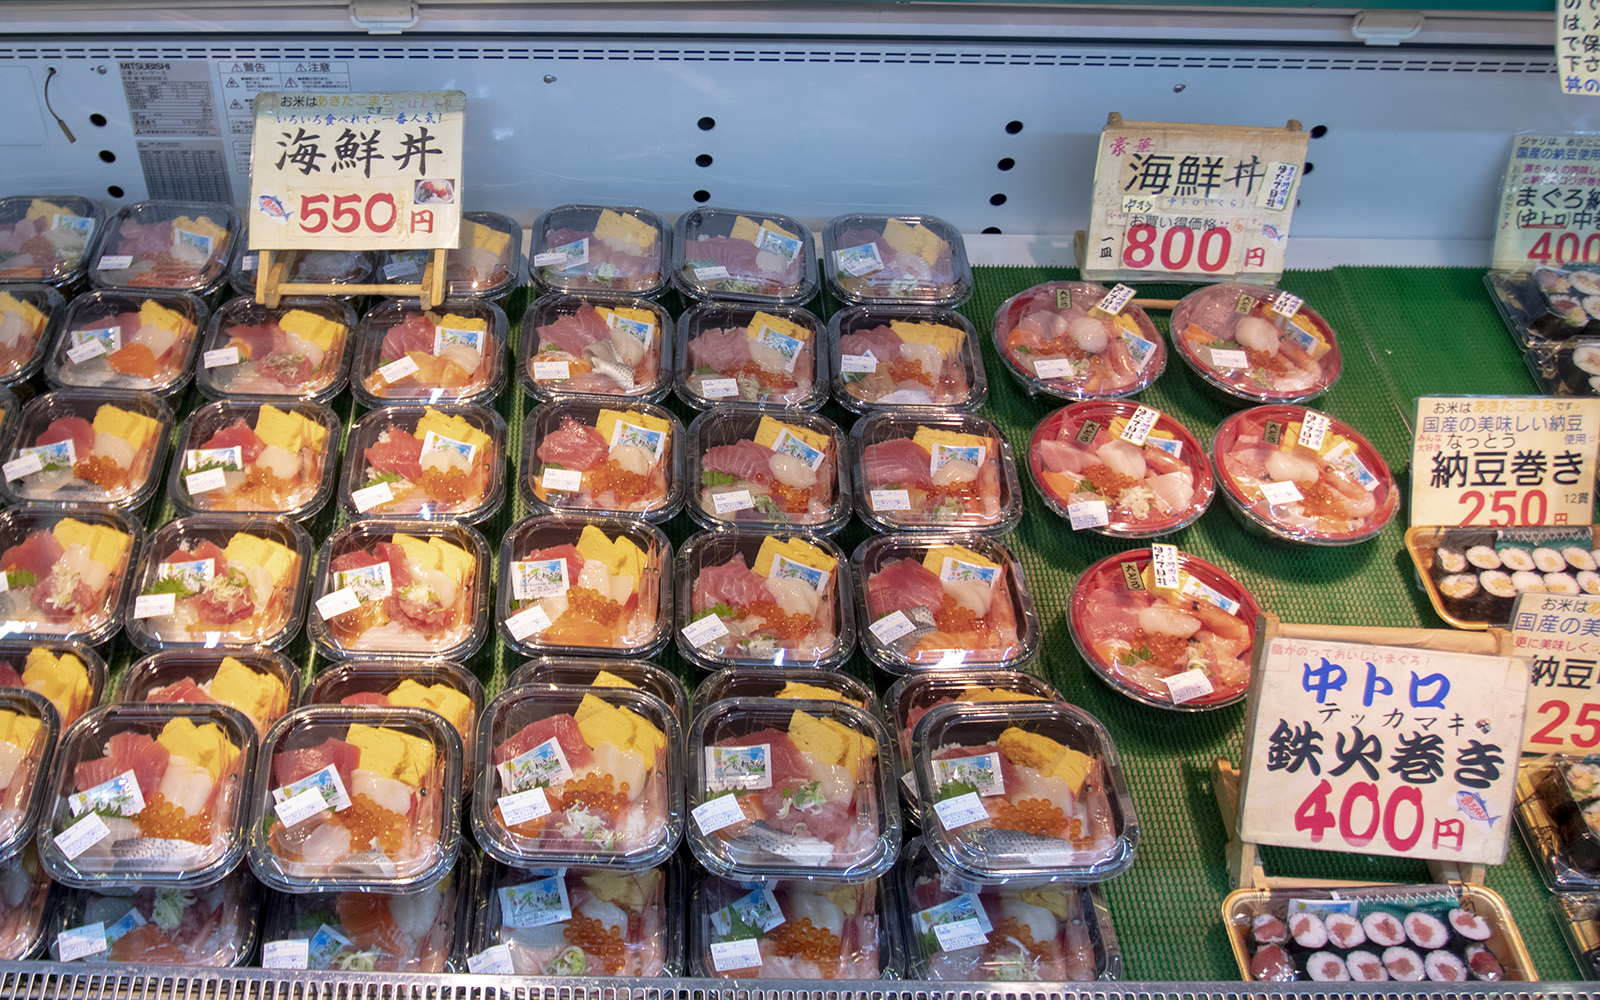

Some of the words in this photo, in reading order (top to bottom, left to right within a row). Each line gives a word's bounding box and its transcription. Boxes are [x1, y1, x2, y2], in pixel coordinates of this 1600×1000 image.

[120, 63, 170, 71] MITSUBISHI
[243, 63, 266, 73] 警告
[308, 62, 331, 73] 注意
[280, 95, 394, 108] お米はあきたこまち
[274, 125, 444, 179] 海鮮丼
[1109, 136, 1156, 158] 豪華
[1122, 152, 1265, 199] 海鮮丼
[1130, 214, 1218, 233] お買い得価格
[1422, 414, 1583, 434] 国産の美味しい納豆
[1446, 433, 1516, 450] なっとう
[1565, 433, 1587, 446] 使用
[1430, 449, 1584, 489] 納豆巻き
[1301, 656, 1453, 711] 中トロ
[1266, 717, 1507, 791] 鉄火巻き
